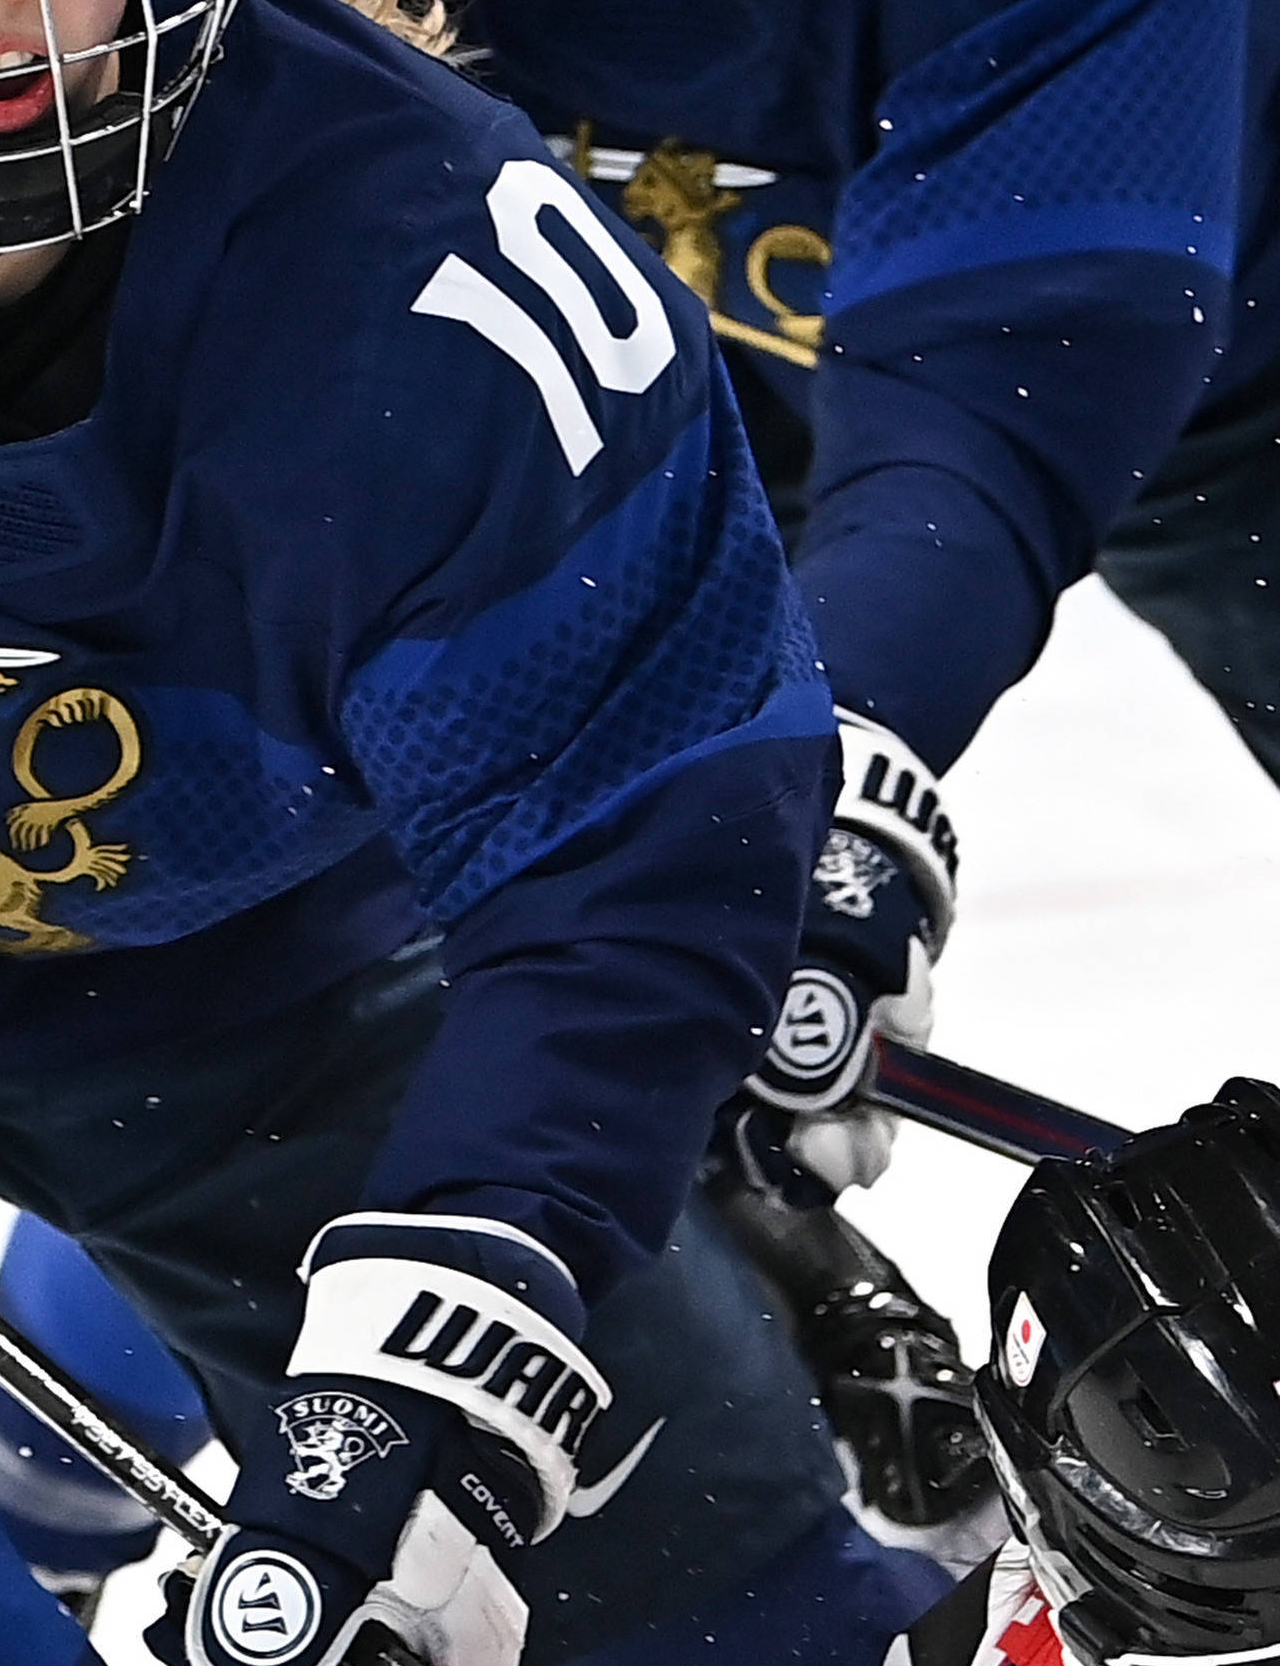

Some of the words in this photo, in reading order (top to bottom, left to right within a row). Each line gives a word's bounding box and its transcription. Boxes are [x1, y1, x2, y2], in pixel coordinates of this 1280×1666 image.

[410, 160, 677, 477] 10
[292, 1397, 388, 1436] SUOMI
[379, 1290, 598, 1457] WAR
[460, 1473, 524, 1547] COVERT
